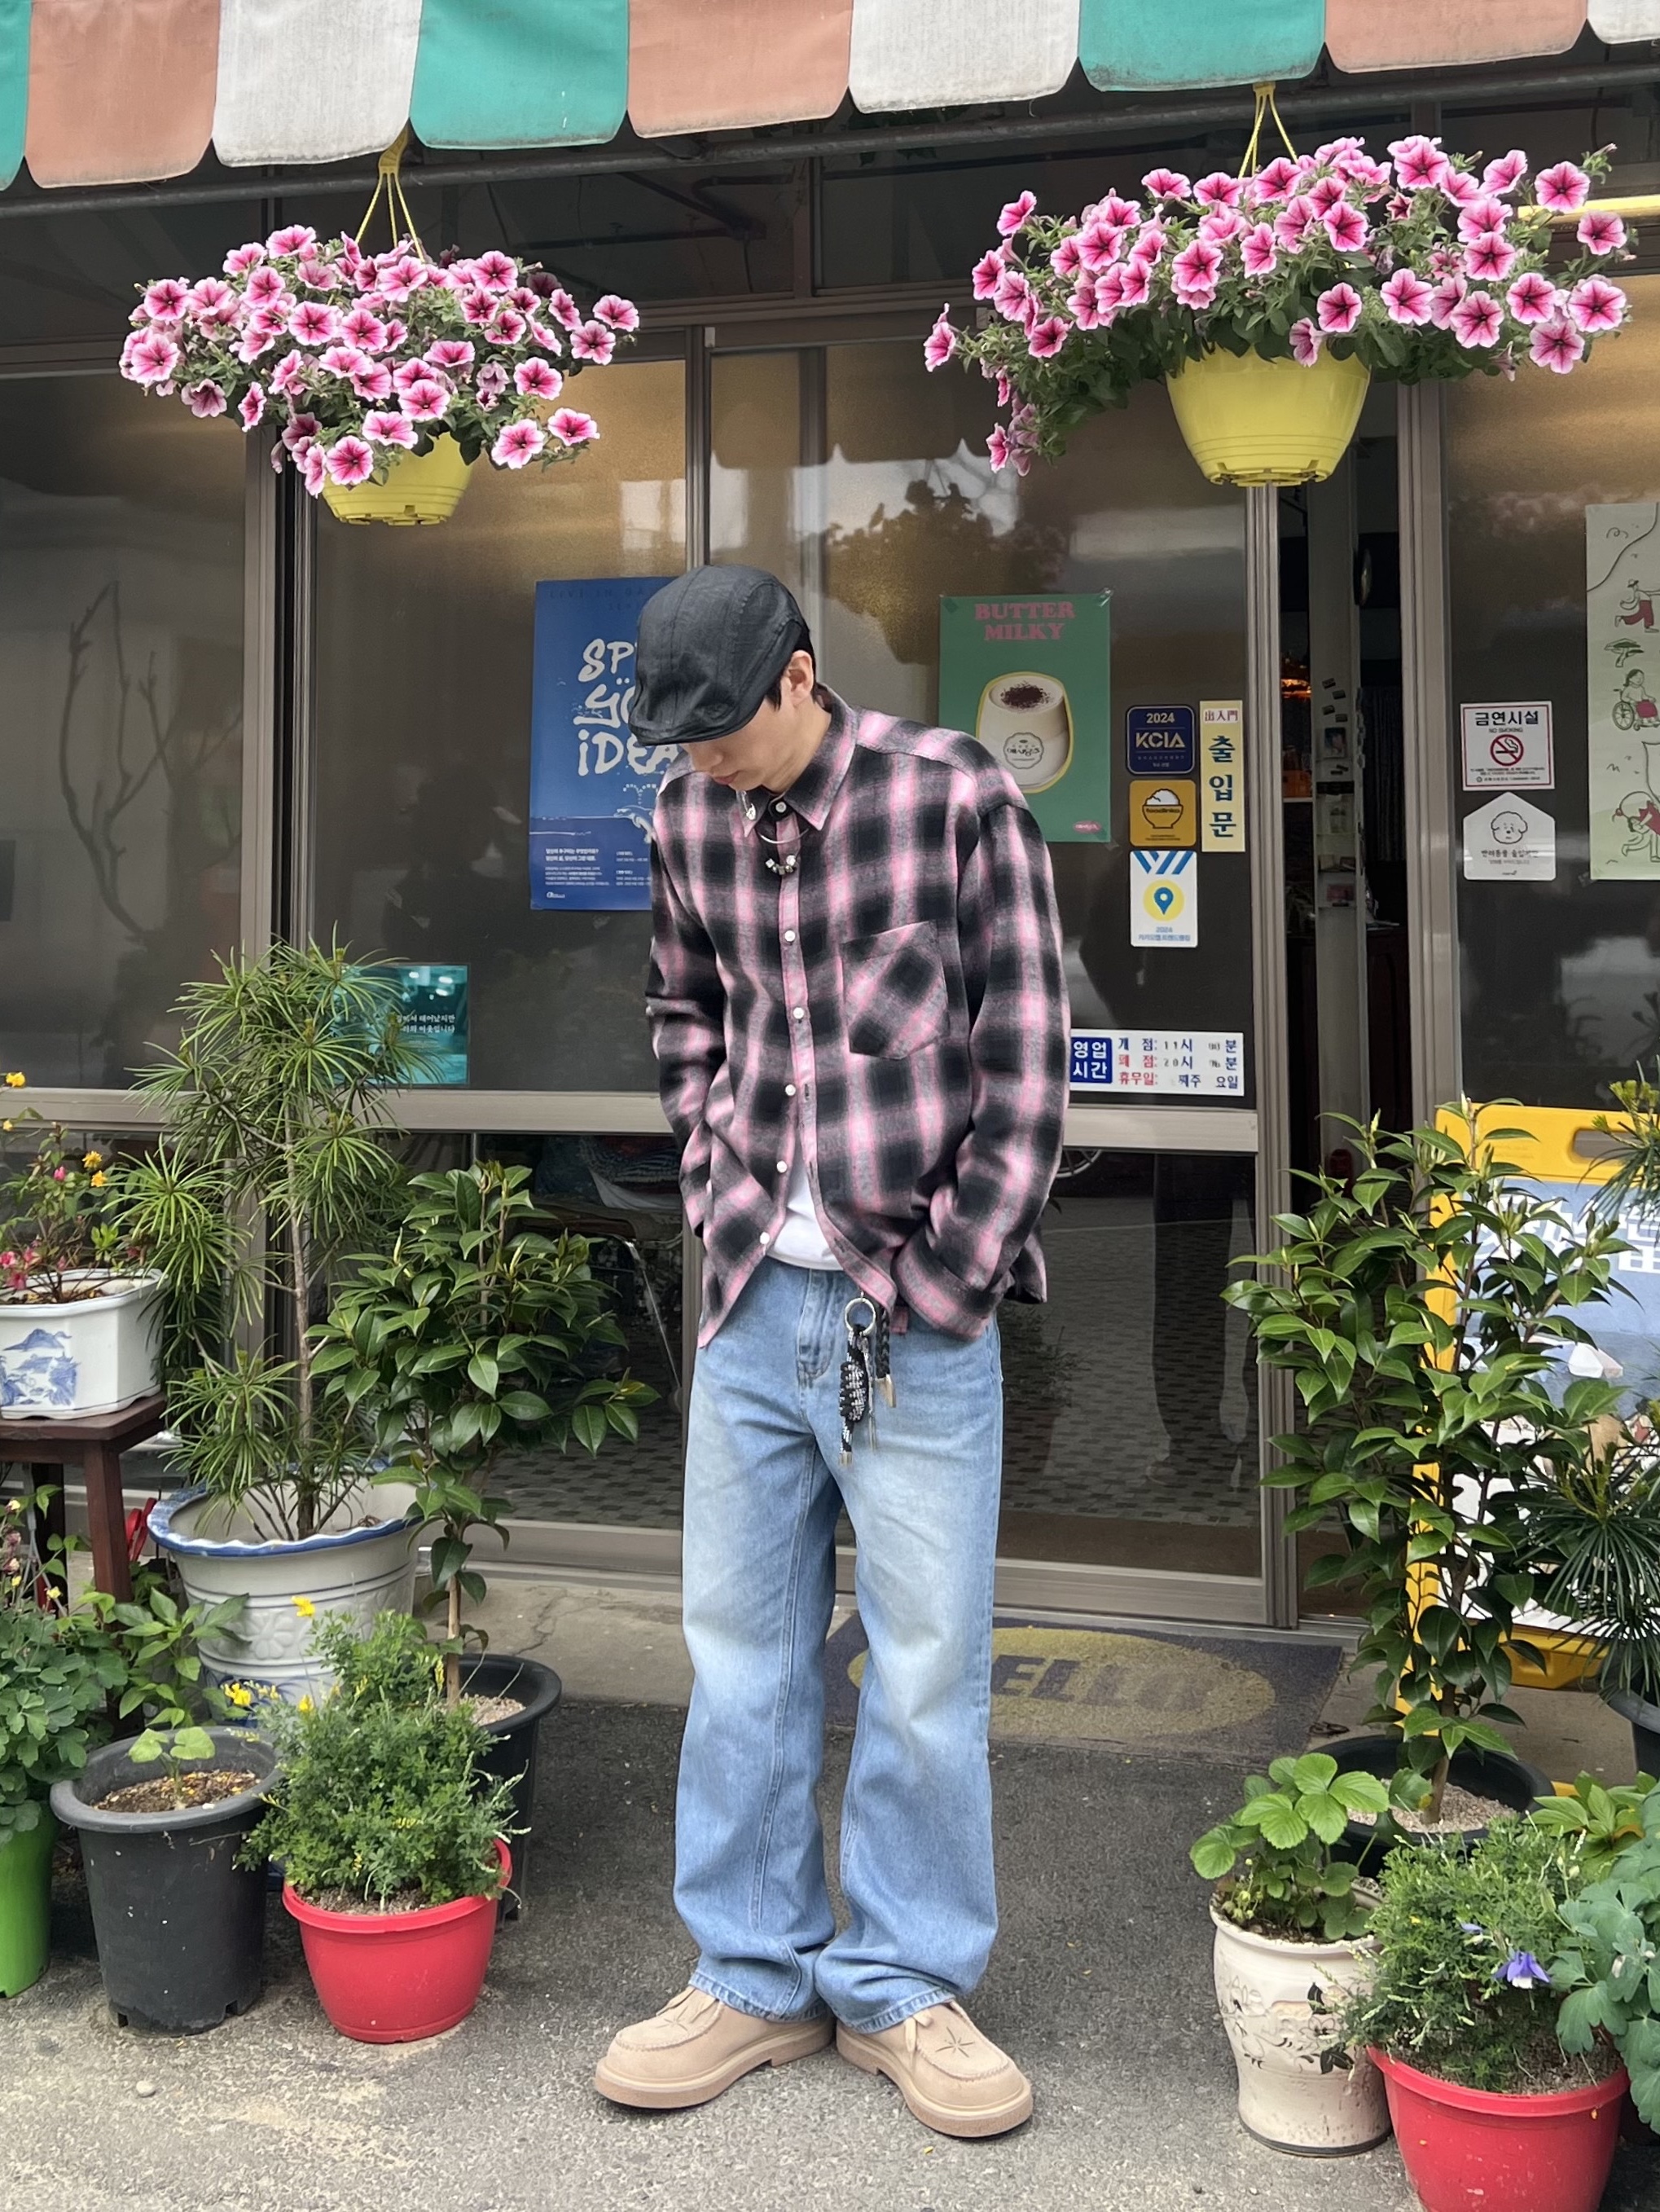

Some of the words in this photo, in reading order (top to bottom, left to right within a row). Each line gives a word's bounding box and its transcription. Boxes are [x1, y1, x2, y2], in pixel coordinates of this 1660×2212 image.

[974, 601, 1076, 621] BUTTER
[984, 622, 1065, 641] MILKY
[577, 638, 638, 683] SP
[1146, 711, 1175, 724] 2024
[1204, 709, 1239, 722] 出入門
[1475, 710, 1539, 727] 금연시설
[1135, 732, 1186, 749] KCIA
[1208, 734, 1237, 838] 출입문
[1073, 1041, 1108, 1059] 영업
[1118, 1037, 1130, 1051] 개
[1072, 1062, 1108, 1080] 시간
[1214, 1075, 1239, 1089] 요일
